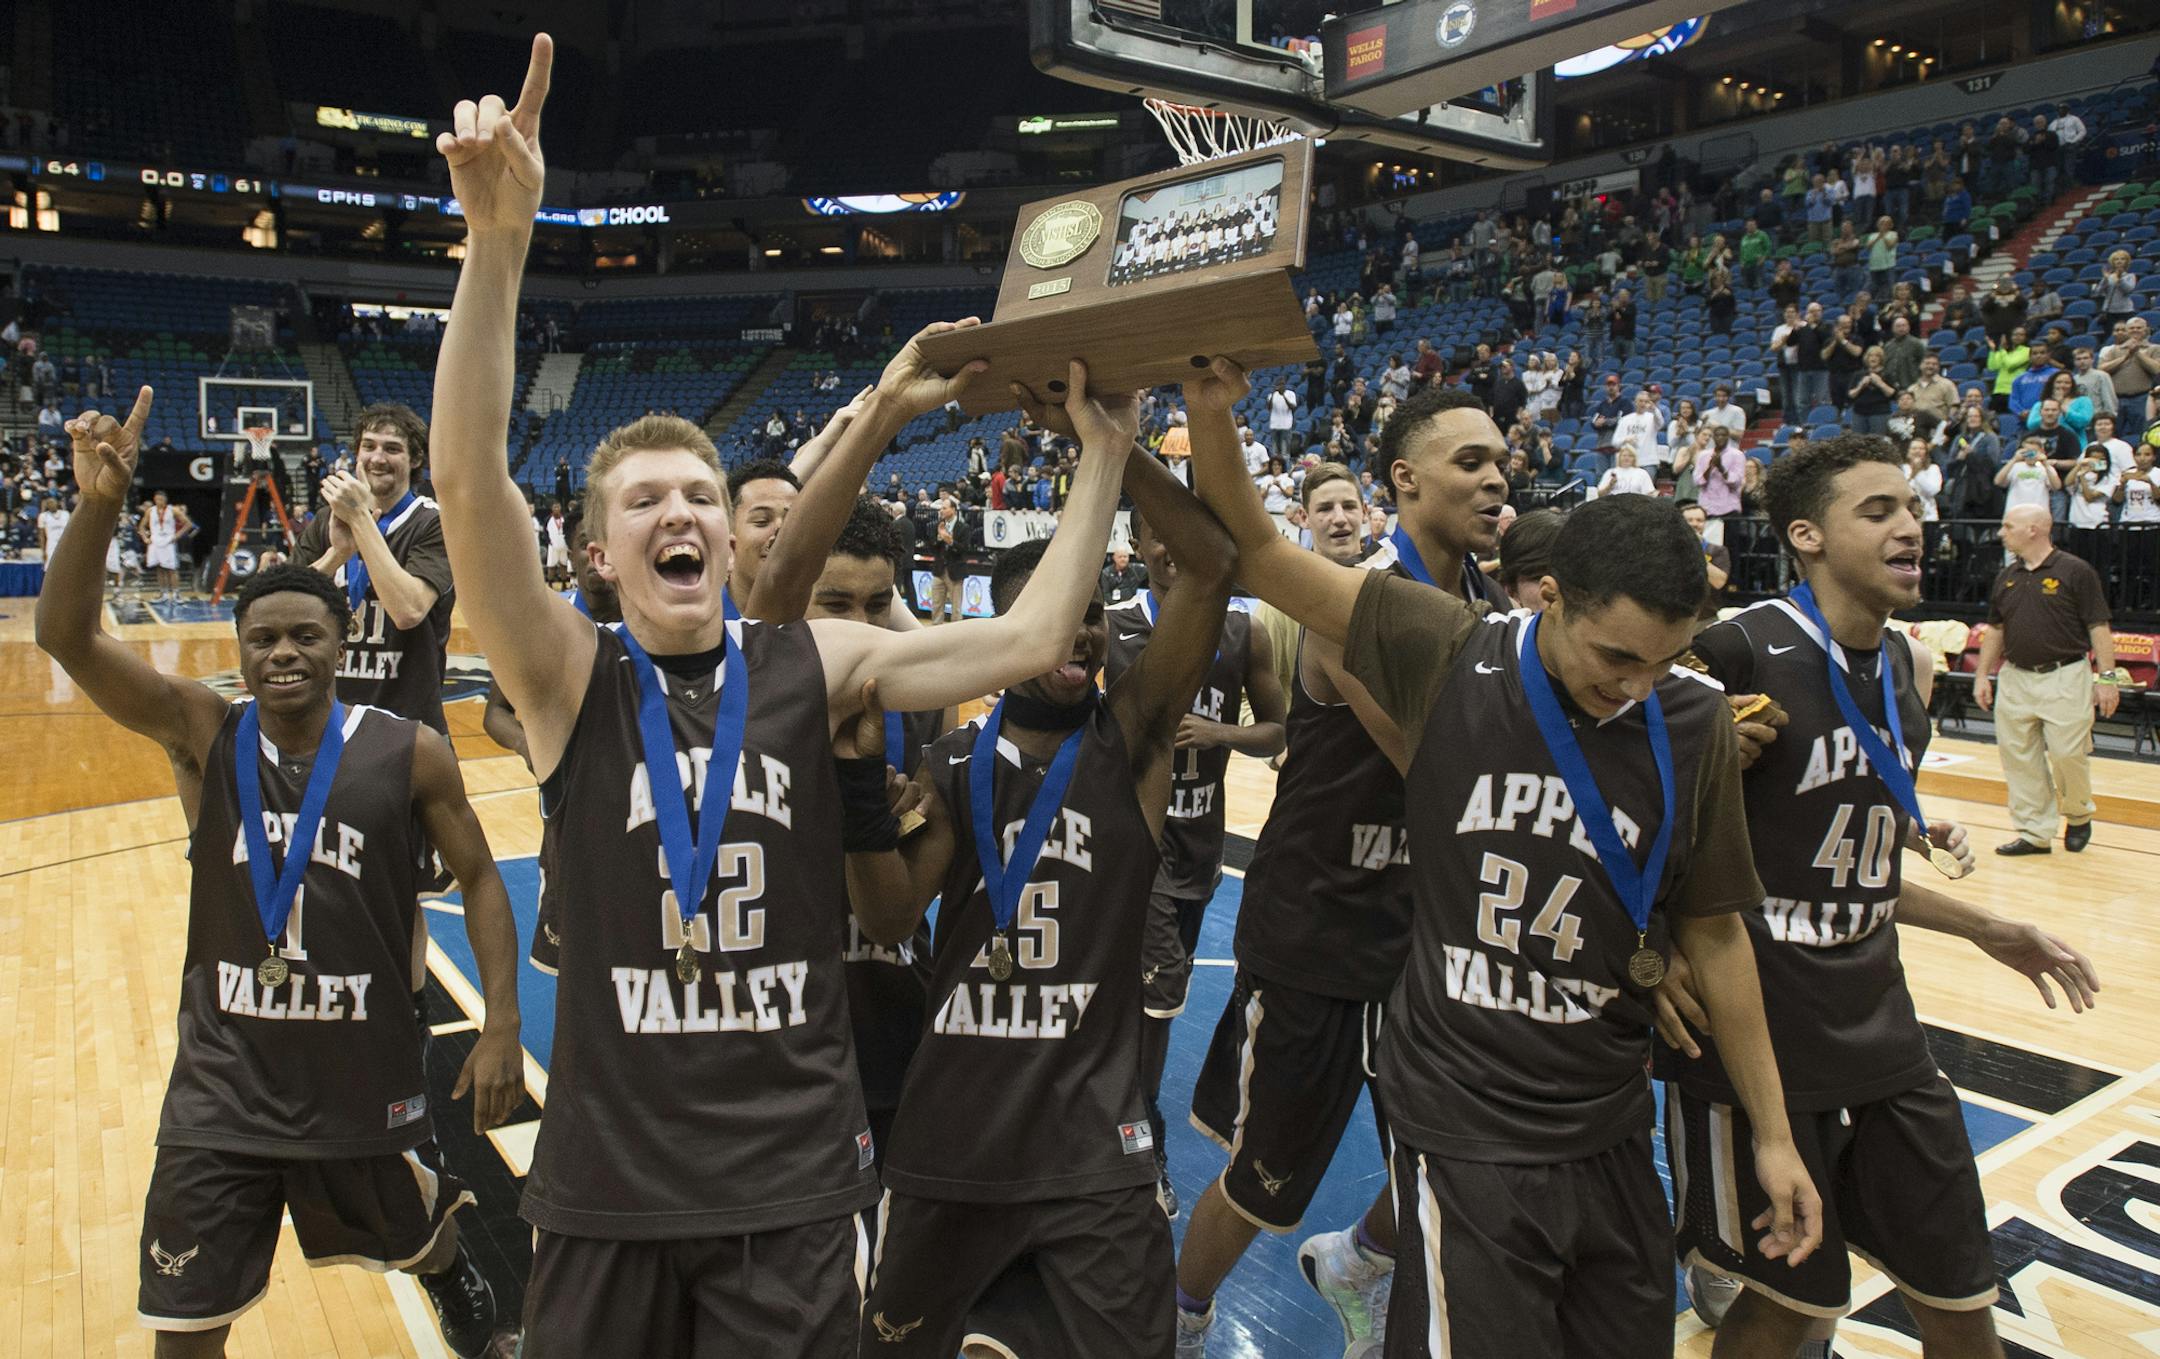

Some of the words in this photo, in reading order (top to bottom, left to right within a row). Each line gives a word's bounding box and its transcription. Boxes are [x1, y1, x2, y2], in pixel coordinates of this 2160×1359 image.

[1348, 38, 1384, 56] WELLS
[1349, 50, 1383, 68] FARGO
[1967, 76, 1991, 92] 131
[47, 160, 79, 176] 64
[141, 169, 184, 187] 0.0
[234, 178, 261, 194] 61
[317, 189, 376, 207] CPHS
[609, 205, 670, 225] CHOOL
[1032, 282, 1068, 297] 2015
[189, 456, 214, 482] G
[334, 649, 404, 680] LLEY
[1811, 803, 1897, 888] 40
[658, 842, 766, 953] 22
[1477, 851, 1584, 963] 24
[278, 883, 308, 961] 1
[217, 960, 372, 1021] VALLEY
[611, 960, 809, 1034] VALLEY
